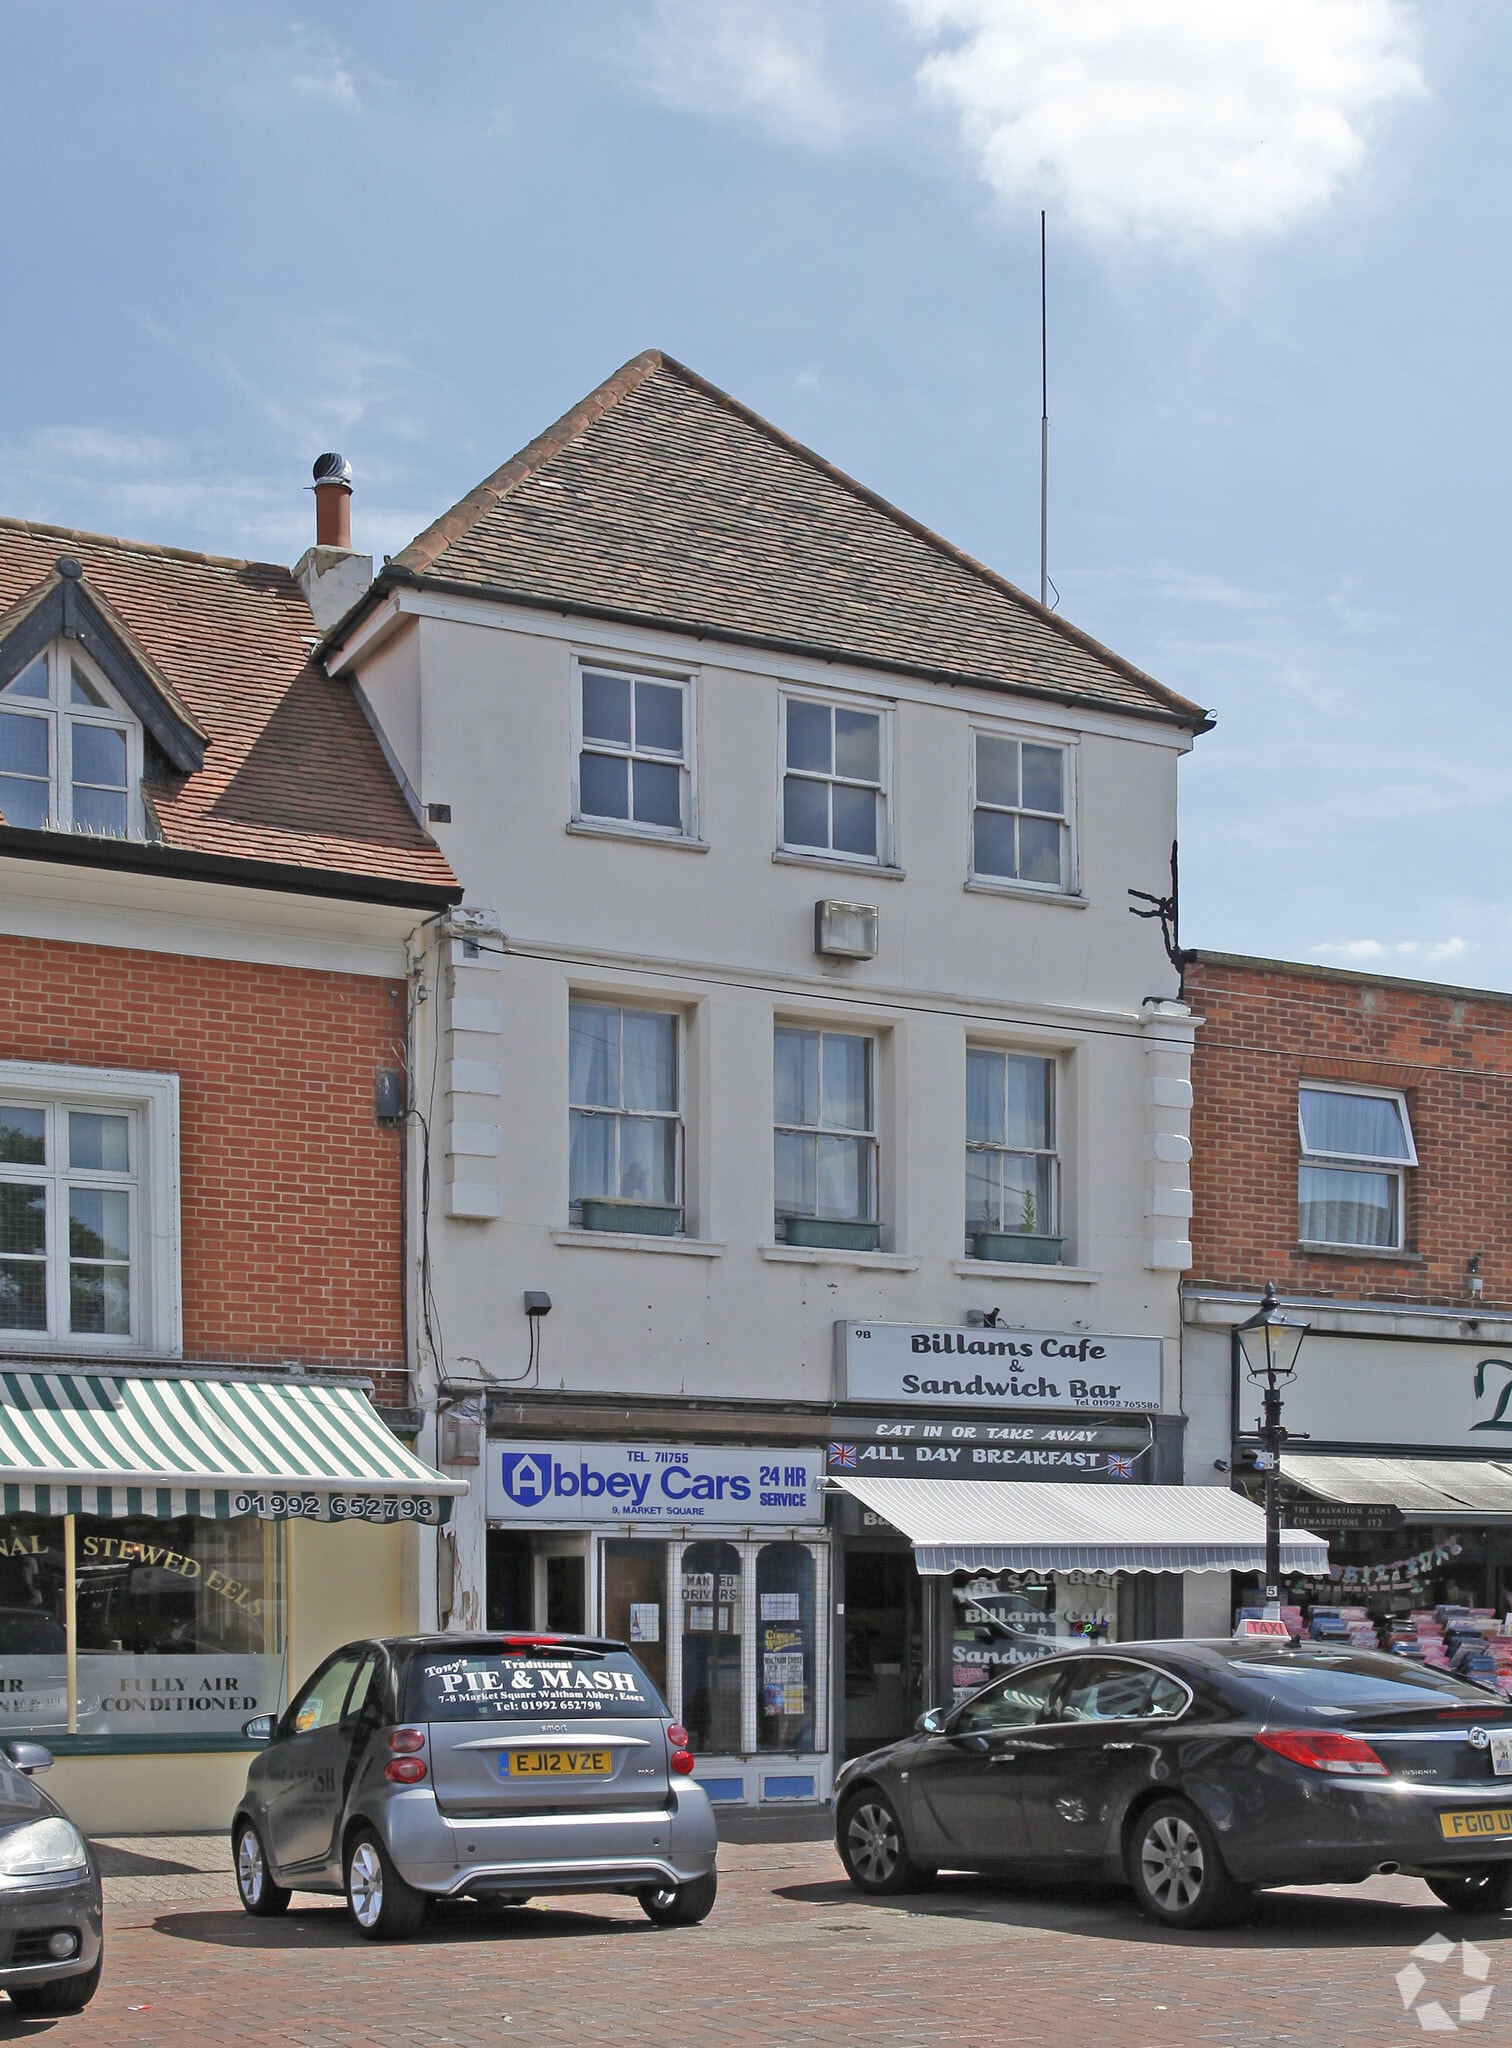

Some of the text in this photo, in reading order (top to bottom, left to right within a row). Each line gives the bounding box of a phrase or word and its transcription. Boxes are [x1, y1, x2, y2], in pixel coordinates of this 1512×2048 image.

[856, 1330, 871, 1339] 9B
[911, 1334, 1107, 1362] Billams Cafe
[1009, 1360, 1025, 1373] &
[902, 1374, 1121, 1399] Sandwich Bar
[1074, 1399, 1159, 1409] Tel 01992 765586
[876, 1424, 1097, 1442] EAT IN OR TAKE AWAY
[627, 1451, 689, 1464] TEL. 711755
[860, 1446, 1099, 1466] ALL DAY BREAKFAST
[508, 1453, 751, 1506] Abbey Cars
[760, 1466, 806, 1487] 24 HR
[234, 1495, 434, 1517] 01992 652798
[760, 1493, 806, 1507] SERVICE
[623, 1507, 662, 1515] MARKET
[666, 1507, 704, 1516] SQUARE
[1294, 1506, 1392, 1515] THE SALVATION ARMY
[83, 1536, 265, 1616] STEWED EELS
[687, 1575, 734, 1587] WANED
[682, 1589, 737, 1600] DRIVRS
[1267, 1586, 1276, 1596] 5
[965, 1608, 1117, 1624] Billams Cafe
[1251, 1621, 1284, 1635] TAXI
[425, 1659, 468, 1678] Tony's
[502, 1659, 573, 1670] Traditional
[120, 1677, 239, 1692] FULLY AIR
[439, 1669, 638, 1693] PIE & MASH
[101, 1696, 257, 1712] CONDITIONED
[438, 1690, 645, 1704] 7-8 Market Square Waltham Abbey, Essex
[494, 1701, 601, 1712] Tel: 01992 652798
[540, 1724, 568, 1732] smart
[517, 1753, 604, 1772] EJ12 VZE
[1452, 1814, 1495, 1834] FG10
